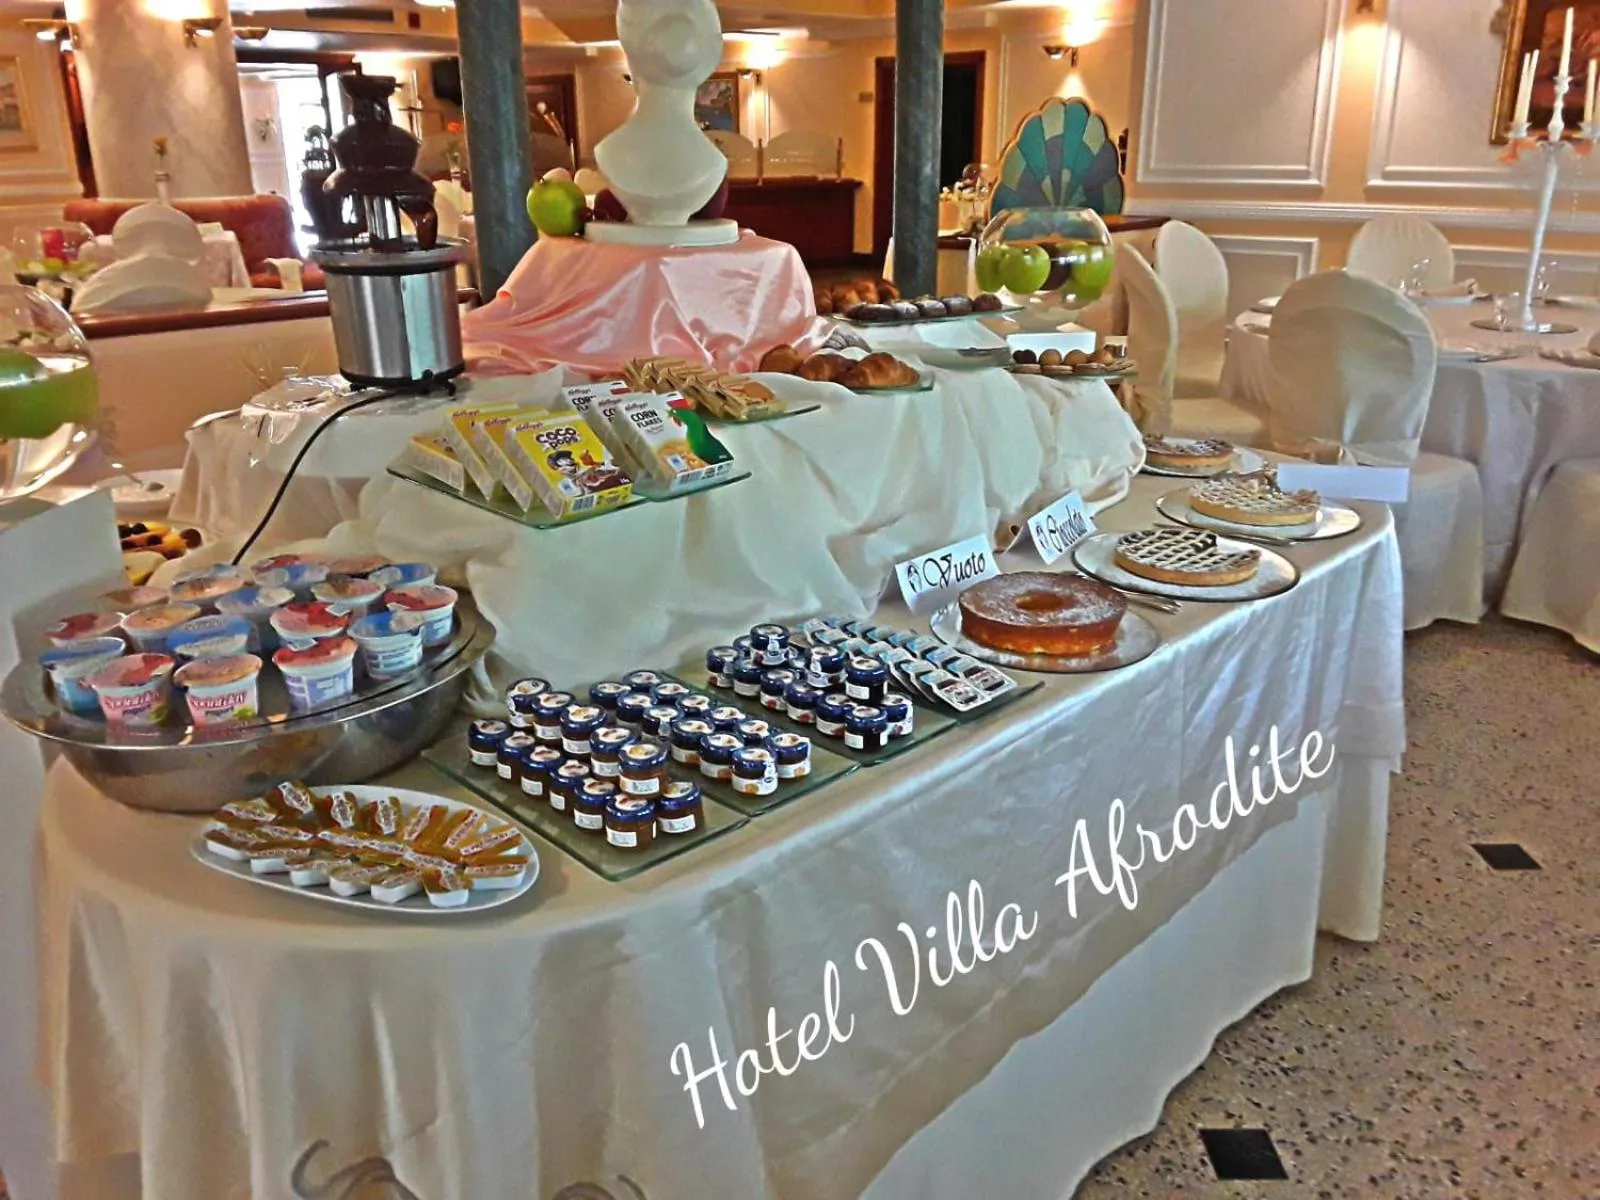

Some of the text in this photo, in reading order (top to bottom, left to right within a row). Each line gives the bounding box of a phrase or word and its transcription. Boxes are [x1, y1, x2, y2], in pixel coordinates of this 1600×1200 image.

[630, 409, 659, 423] CORN
[635, 417, 663, 429] FLAKES
[922, 552, 986, 590] Vuoto
